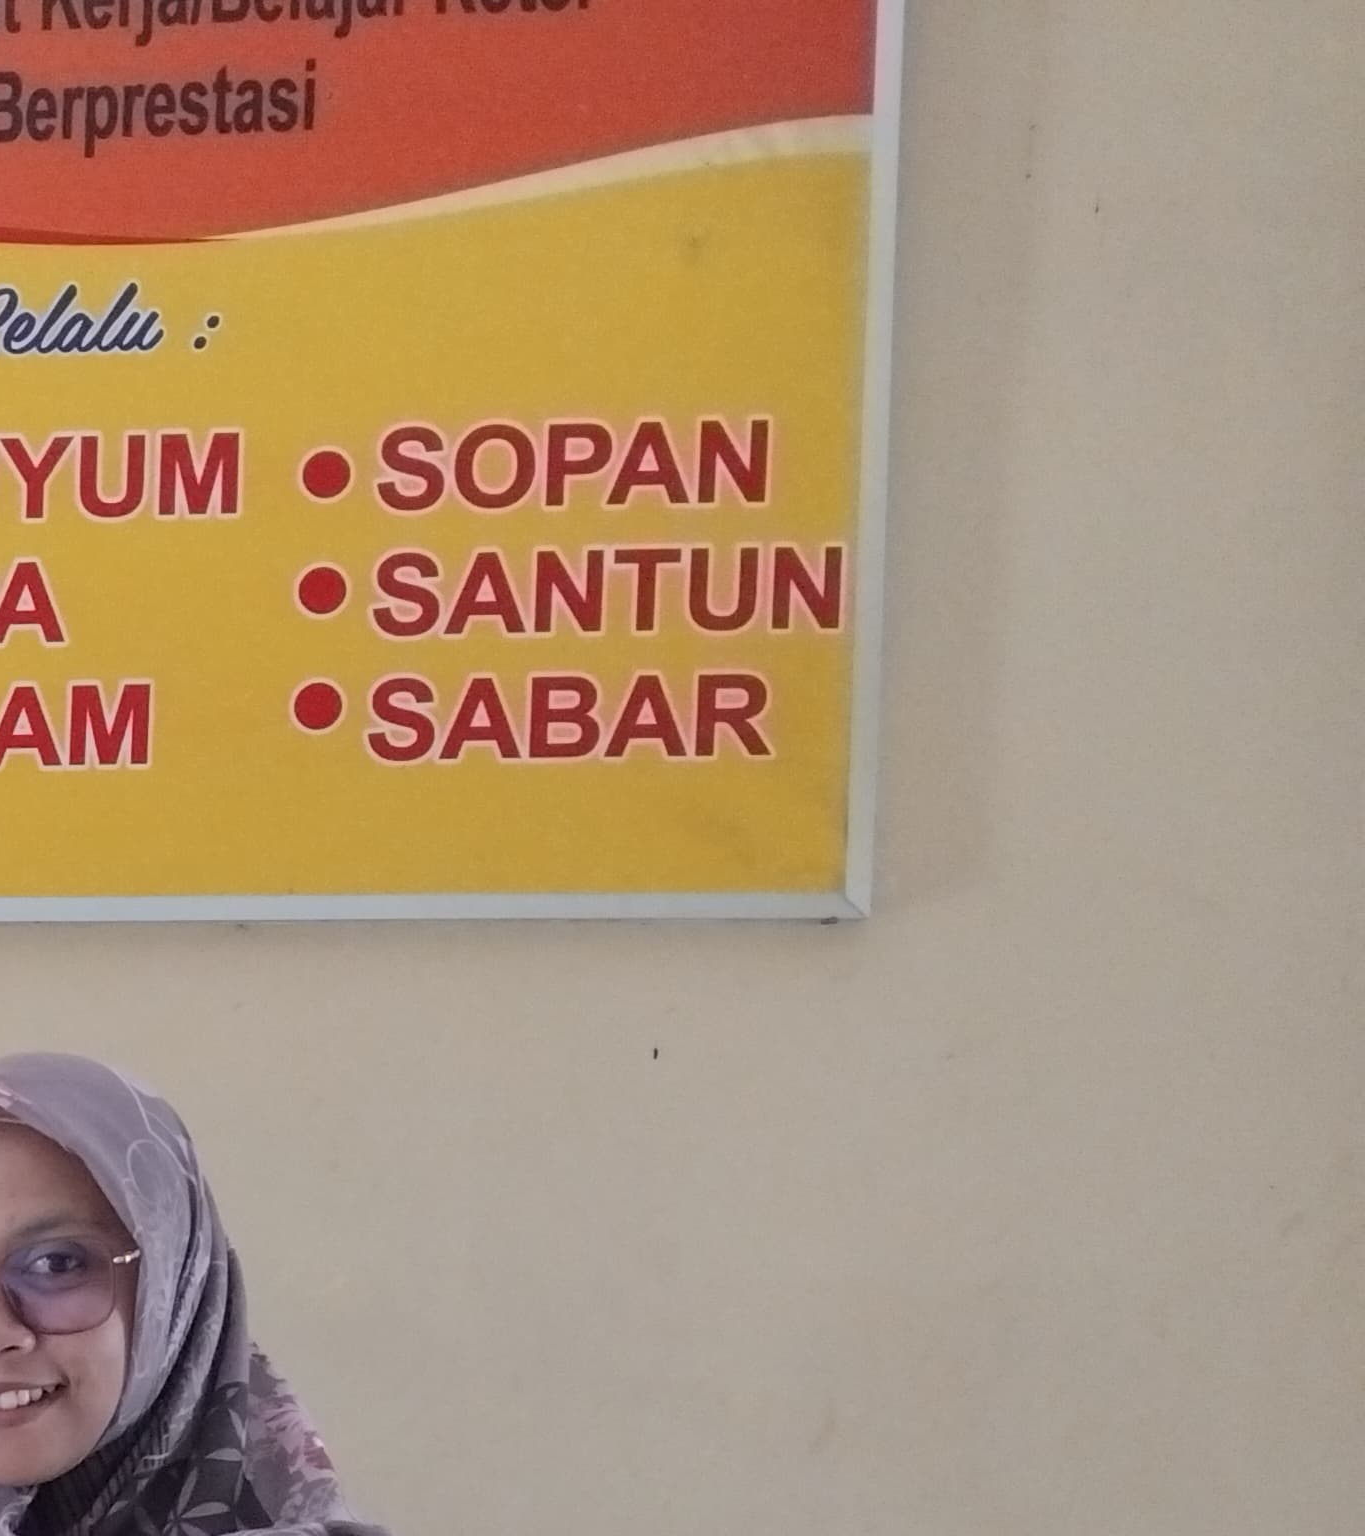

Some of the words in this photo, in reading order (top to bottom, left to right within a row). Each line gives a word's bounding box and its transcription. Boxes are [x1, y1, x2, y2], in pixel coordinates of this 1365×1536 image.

[376, 418, 770, 512] SOPAN
[371, 545, 844, 637] SANTUN
[367, 673, 773, 762] SABAR
